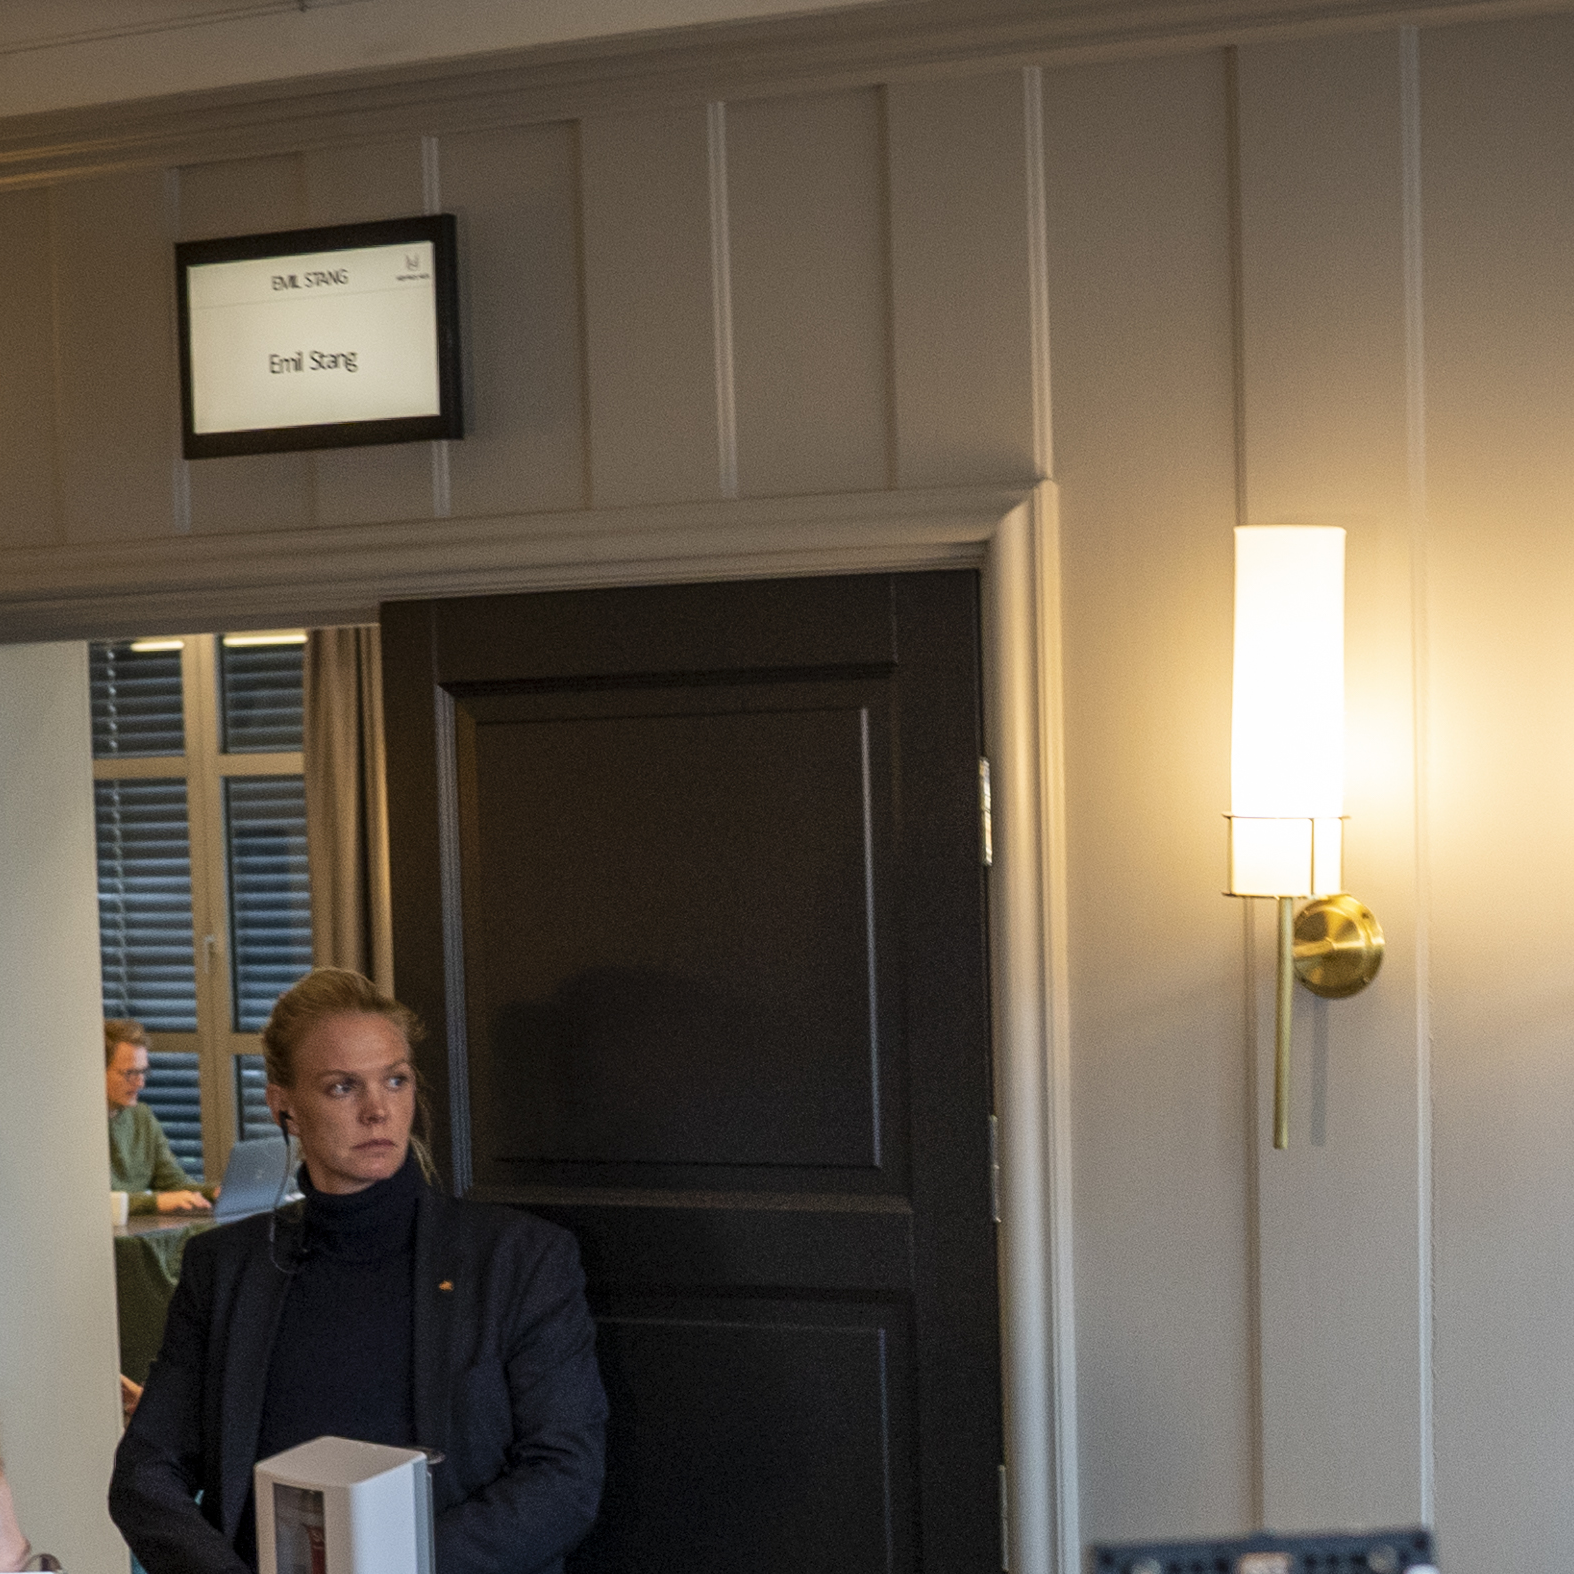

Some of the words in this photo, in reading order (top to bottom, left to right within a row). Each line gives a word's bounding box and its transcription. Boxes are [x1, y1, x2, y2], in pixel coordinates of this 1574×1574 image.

[272, 274, 301, 291] EMIL
[305, 270, 349, 289] STANG
[269, 352, 303, 374] Emil
[310, 350, 358, 373] Stang
